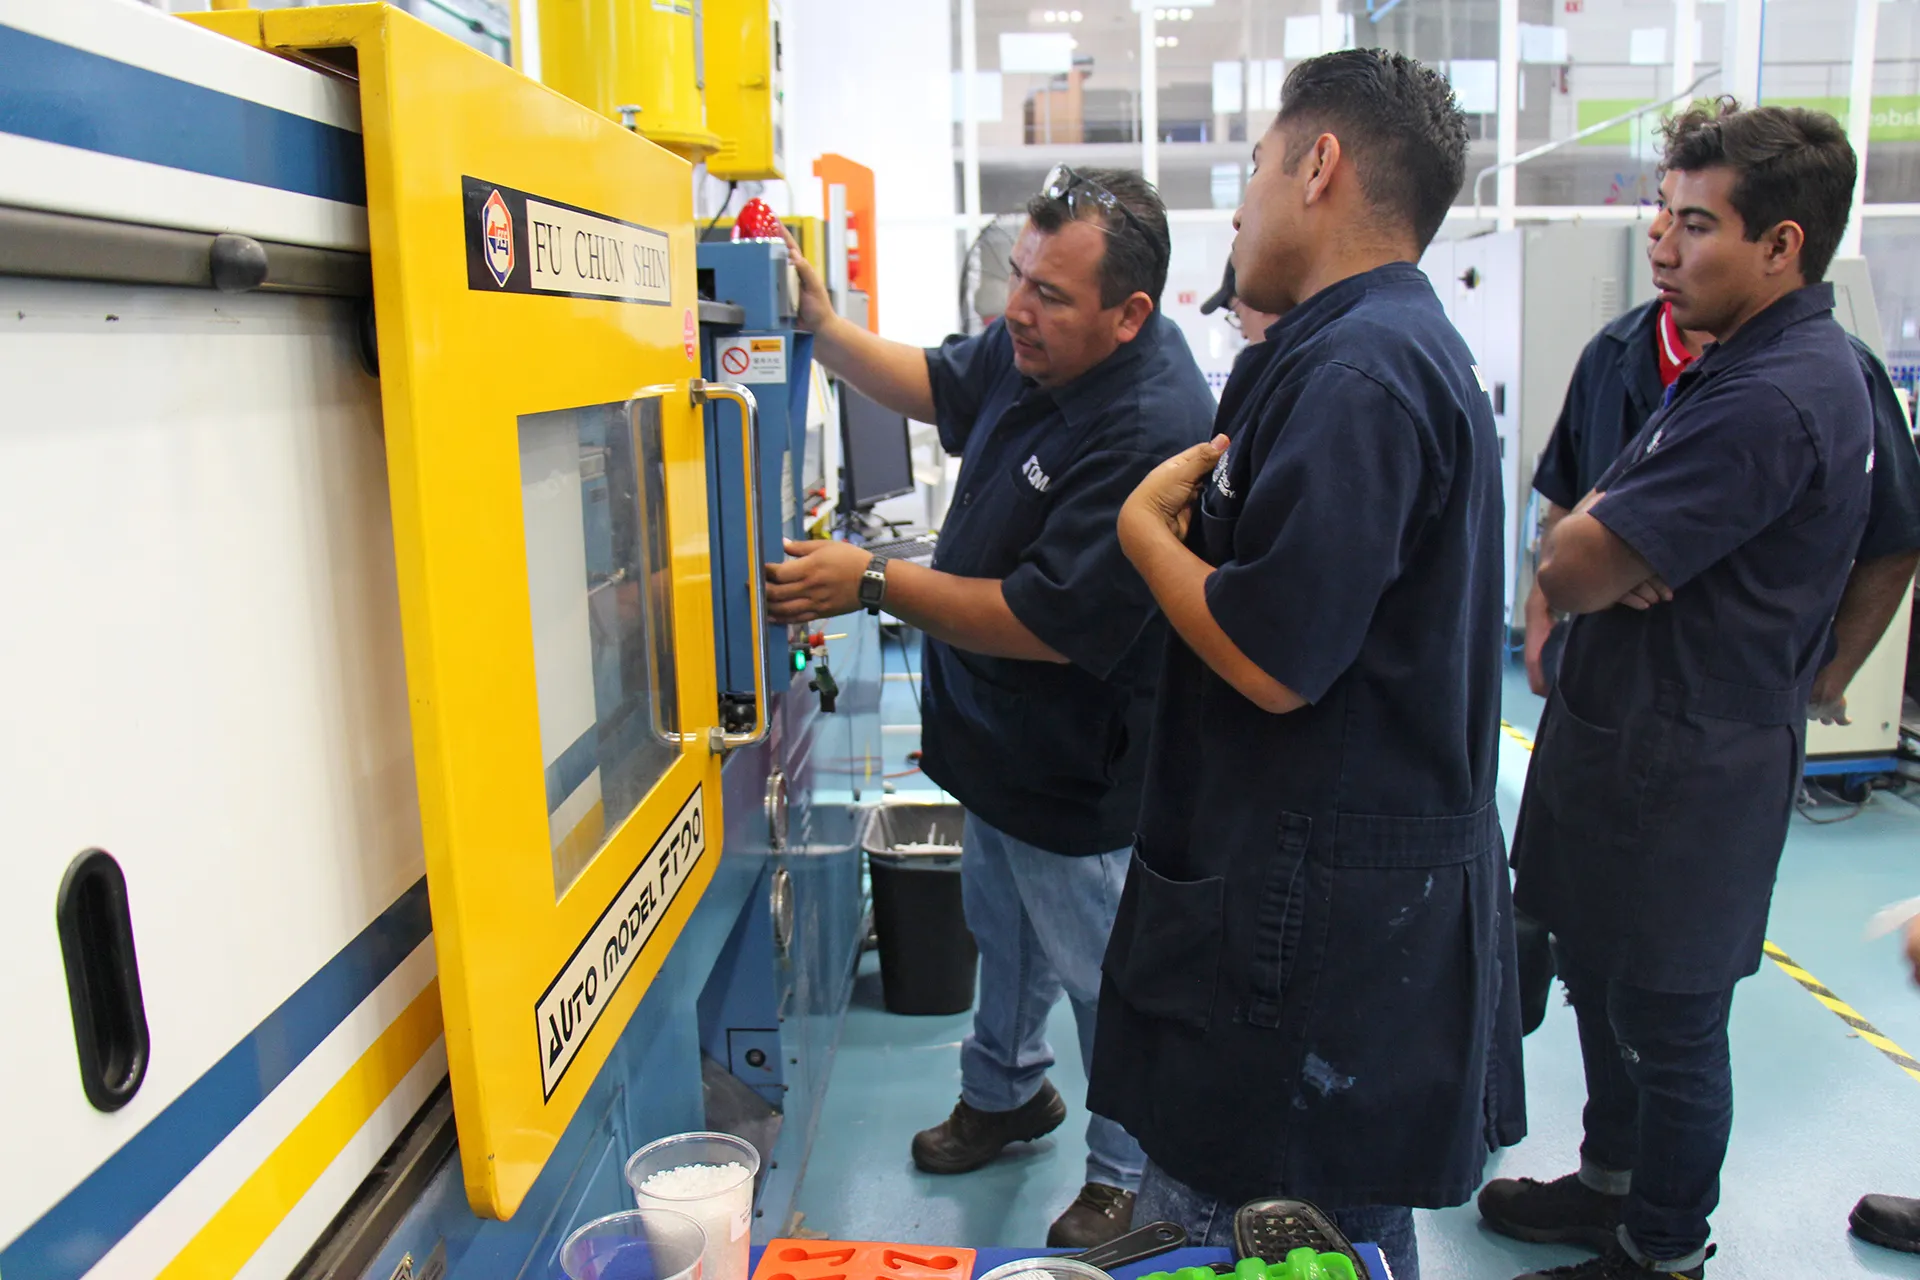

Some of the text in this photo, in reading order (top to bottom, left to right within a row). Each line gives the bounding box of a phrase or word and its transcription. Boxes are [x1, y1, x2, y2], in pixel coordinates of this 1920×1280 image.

[533, 221, 667, 289] FU CHUN SHIN
[549, 965, 598, 1069] AUTO
[603, 881, 657, 983] MODEL
